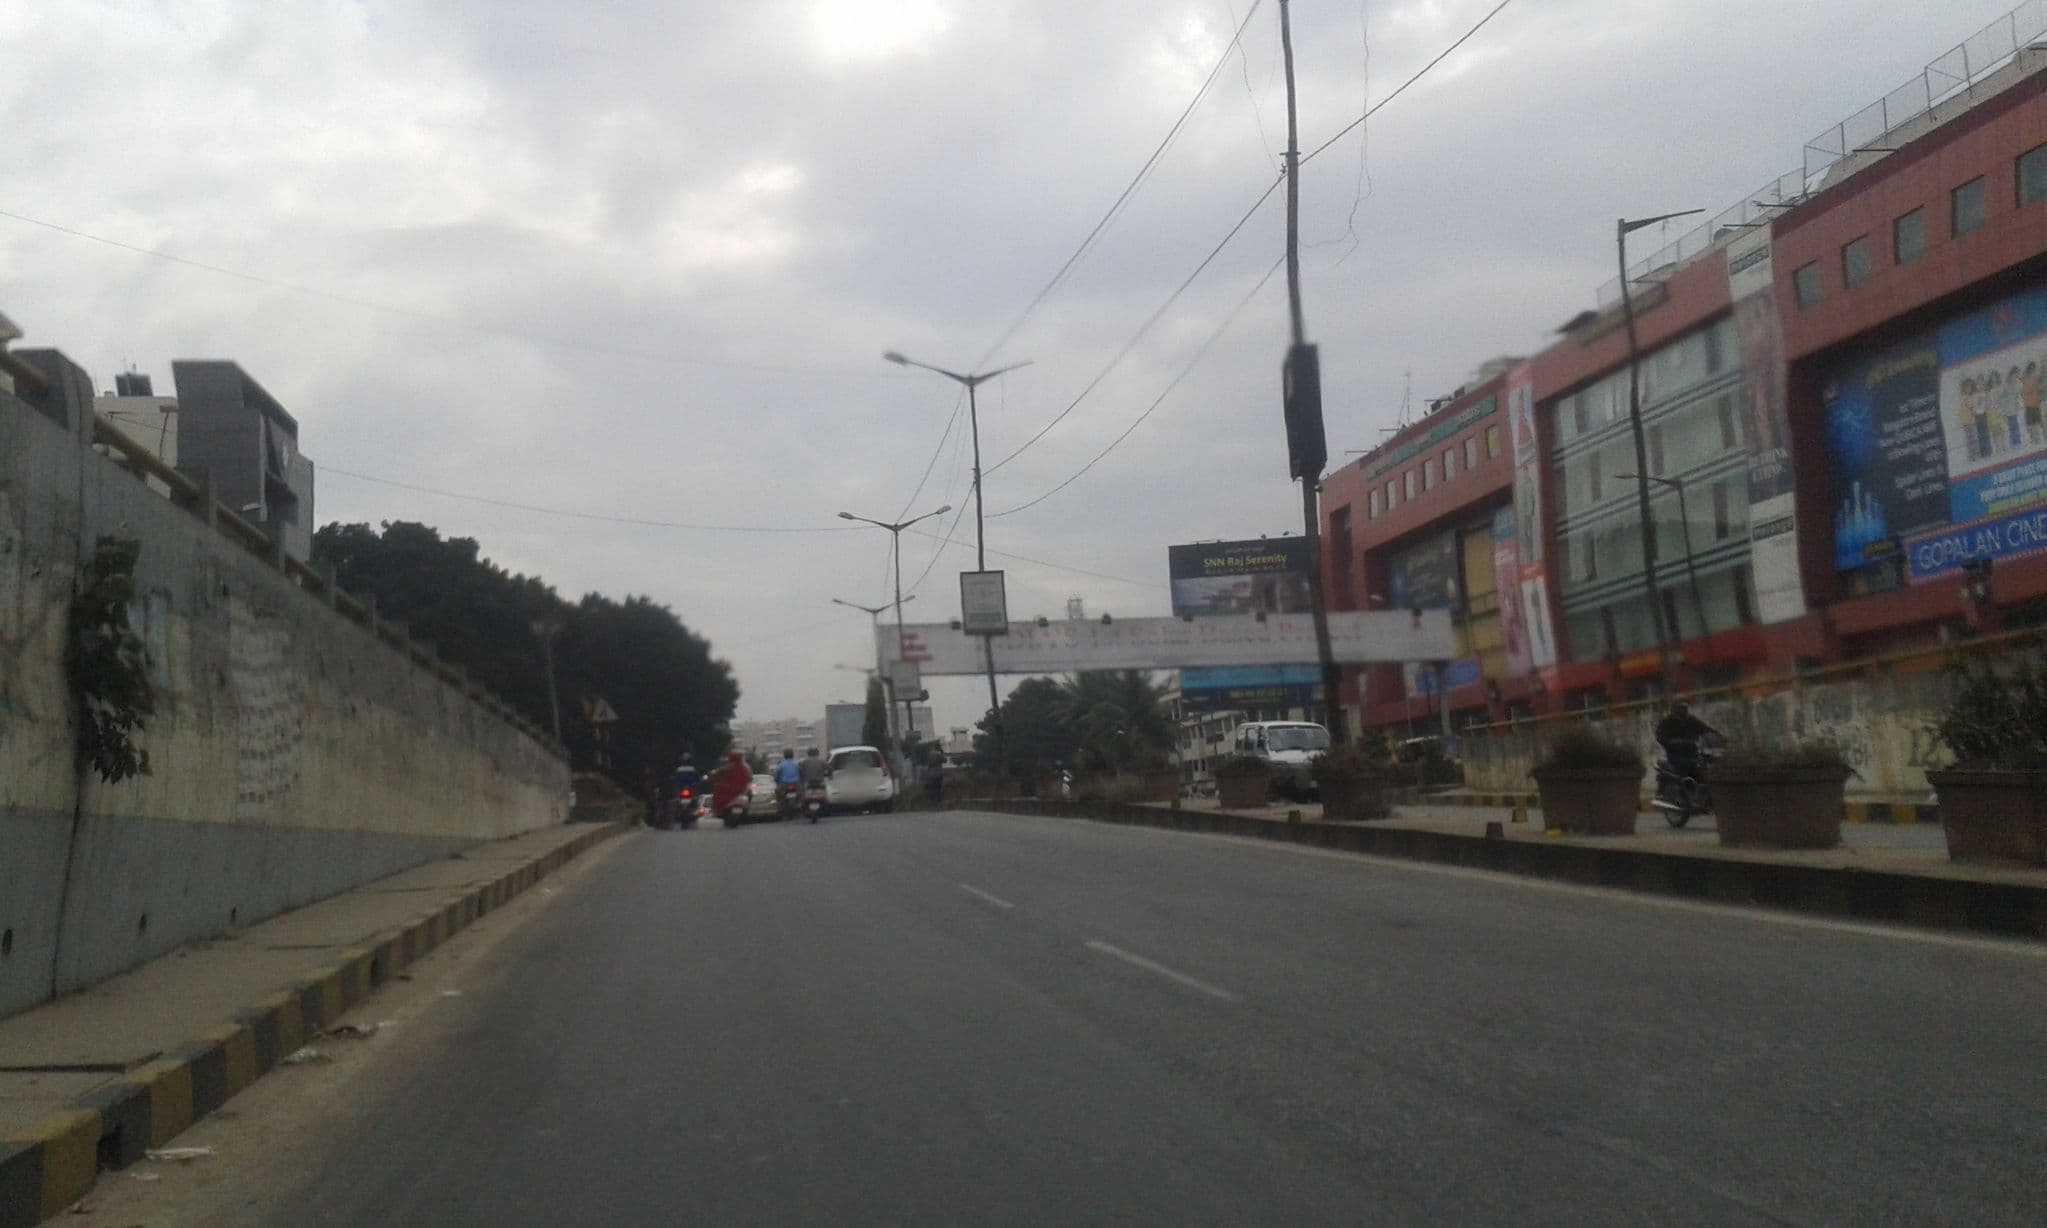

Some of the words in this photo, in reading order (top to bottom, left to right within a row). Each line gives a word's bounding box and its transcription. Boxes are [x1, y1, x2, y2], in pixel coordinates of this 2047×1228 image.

[1204, 557, 1225, 568] SNN
[1246, 553, 1287, 566] Serenity
[1919, 525, 2001, 569] GOPALAN
